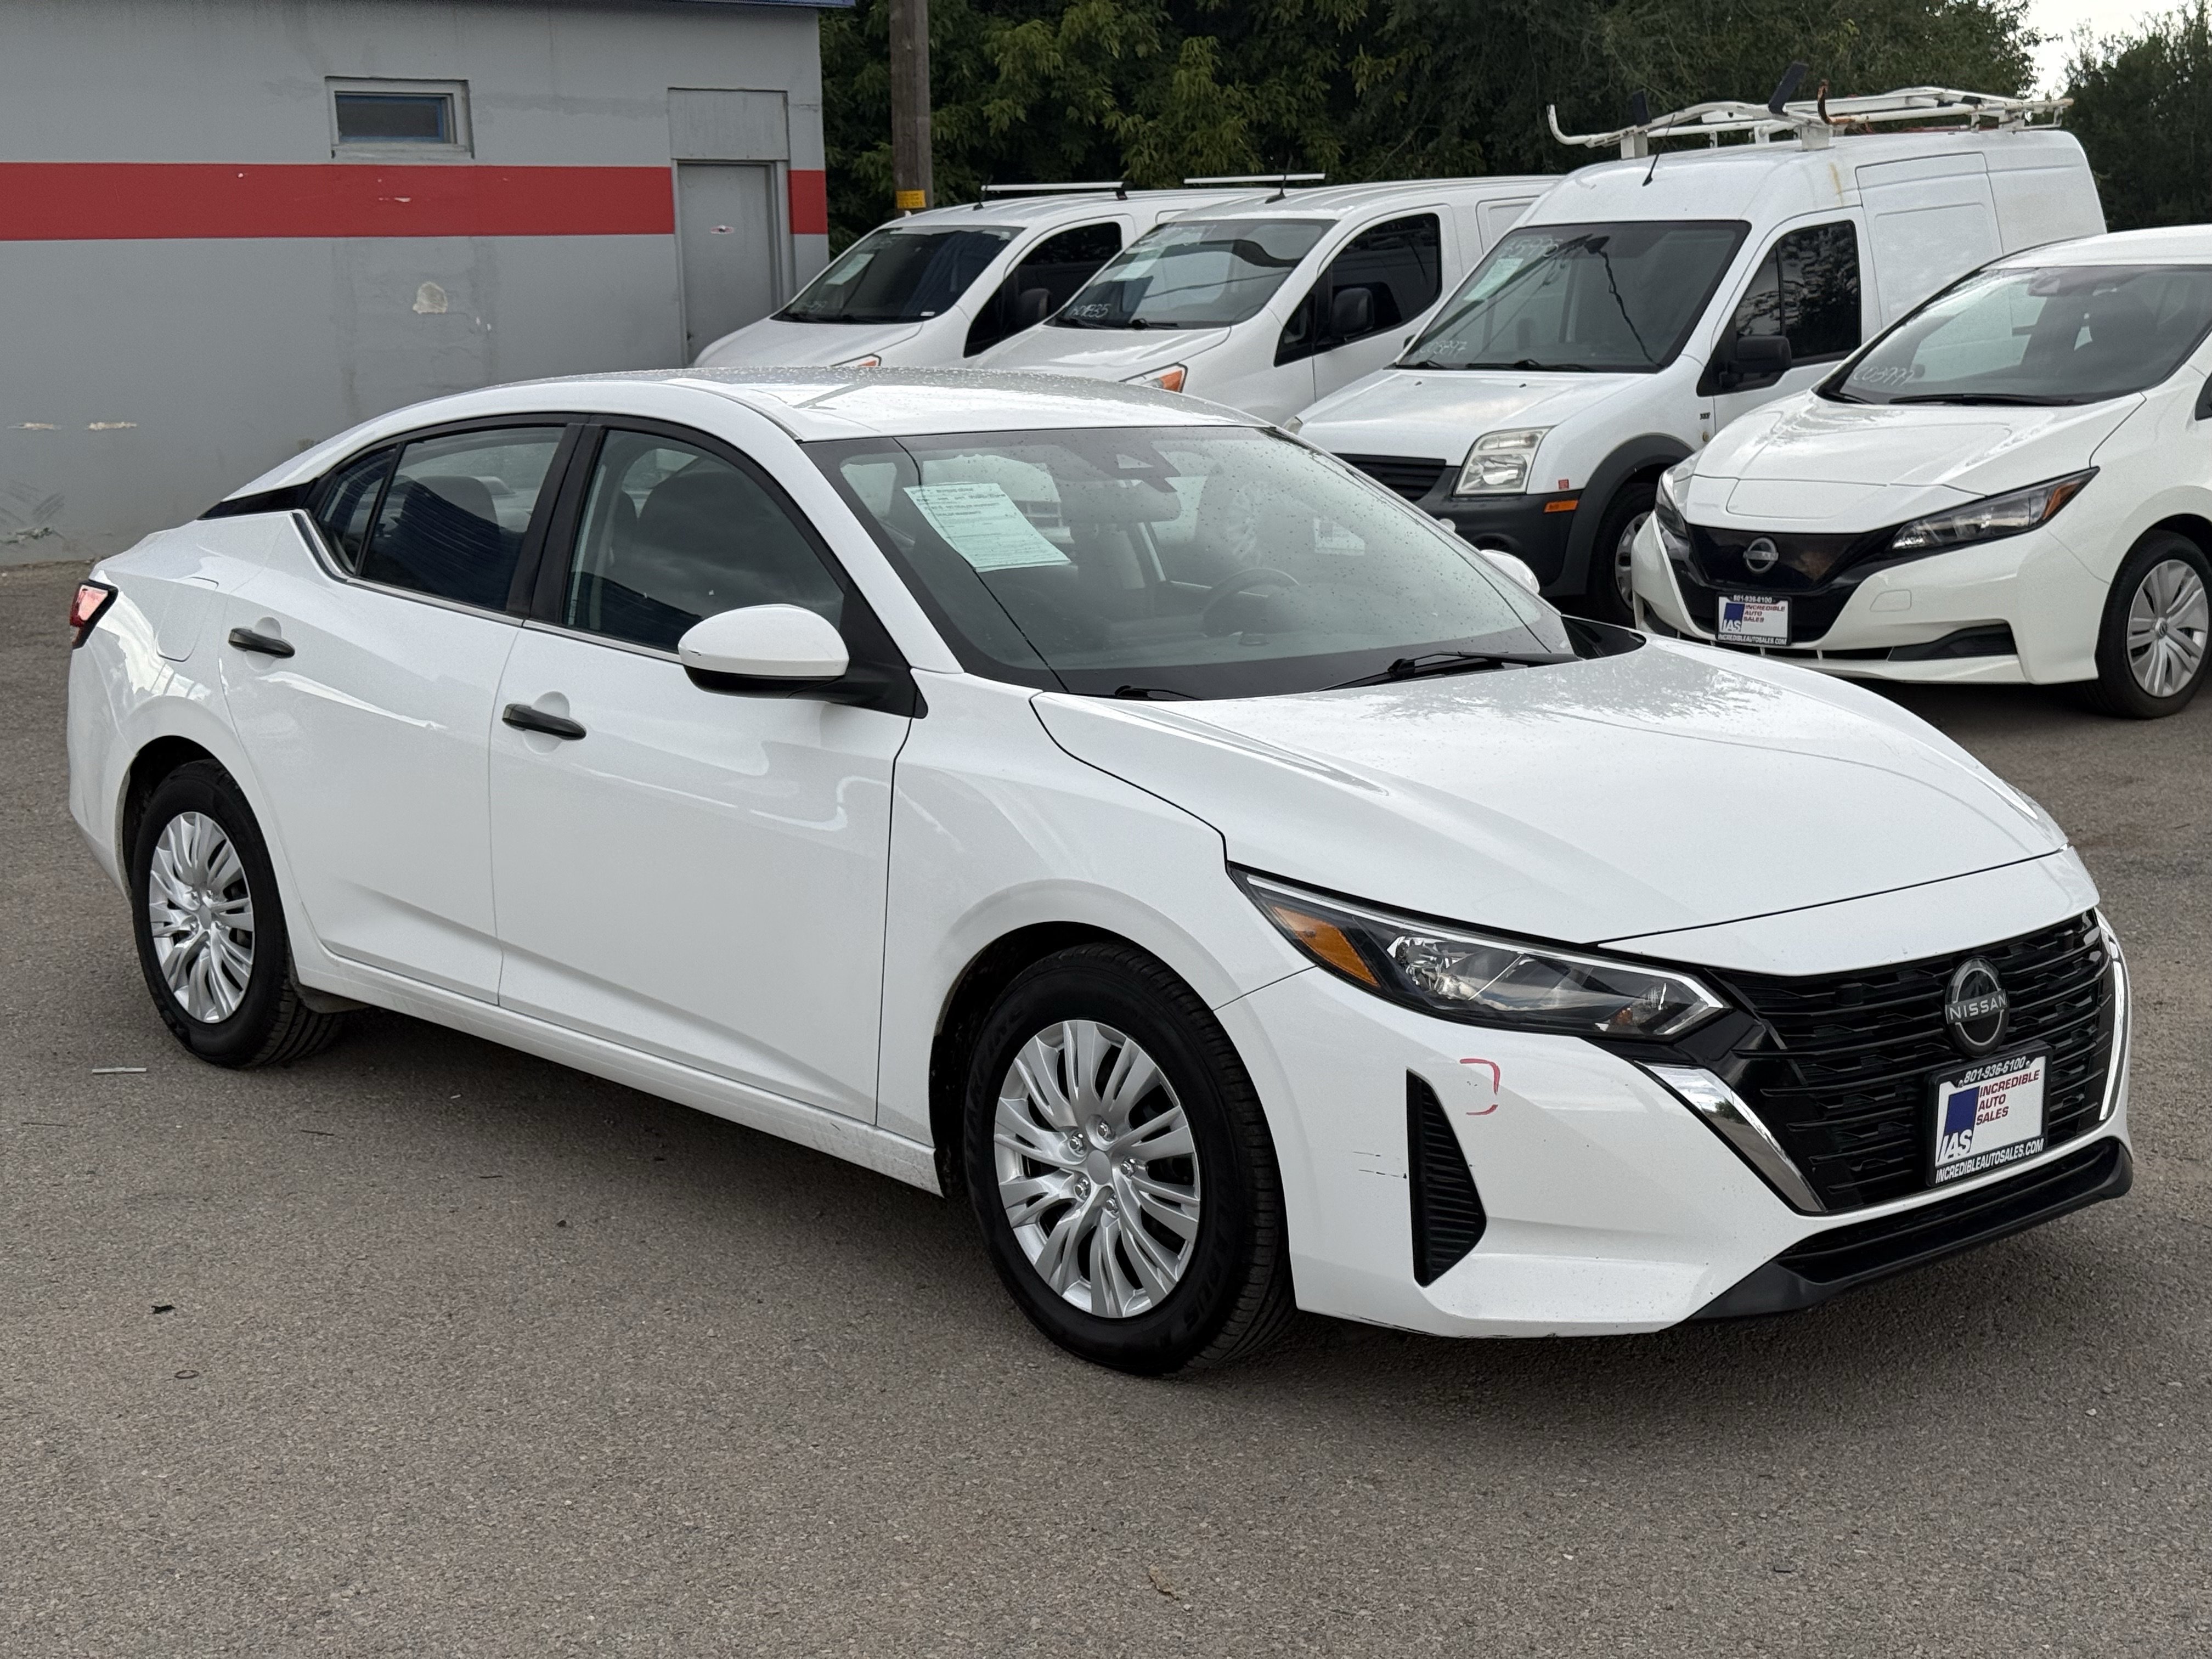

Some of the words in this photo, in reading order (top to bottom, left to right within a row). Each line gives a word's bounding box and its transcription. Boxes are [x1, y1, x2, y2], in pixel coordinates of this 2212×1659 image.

[1723, 618, 1741, 632] IAS
[1949, 994, 2006, 1020] NISSAN
[1963, 1056, 2027, 1084] 801-936-6100
[1979, 1069, 2041, 1098] INCREDIBLE
[1976, 1106, 2009, 1126] SALES
[1978, 1093, 2006, 1112] AUTO
[1940, 1128, 1973, 1160] IAS
[1935, 1138, 2045, 1184] INCREDIBLEAUTOSALES.COM
